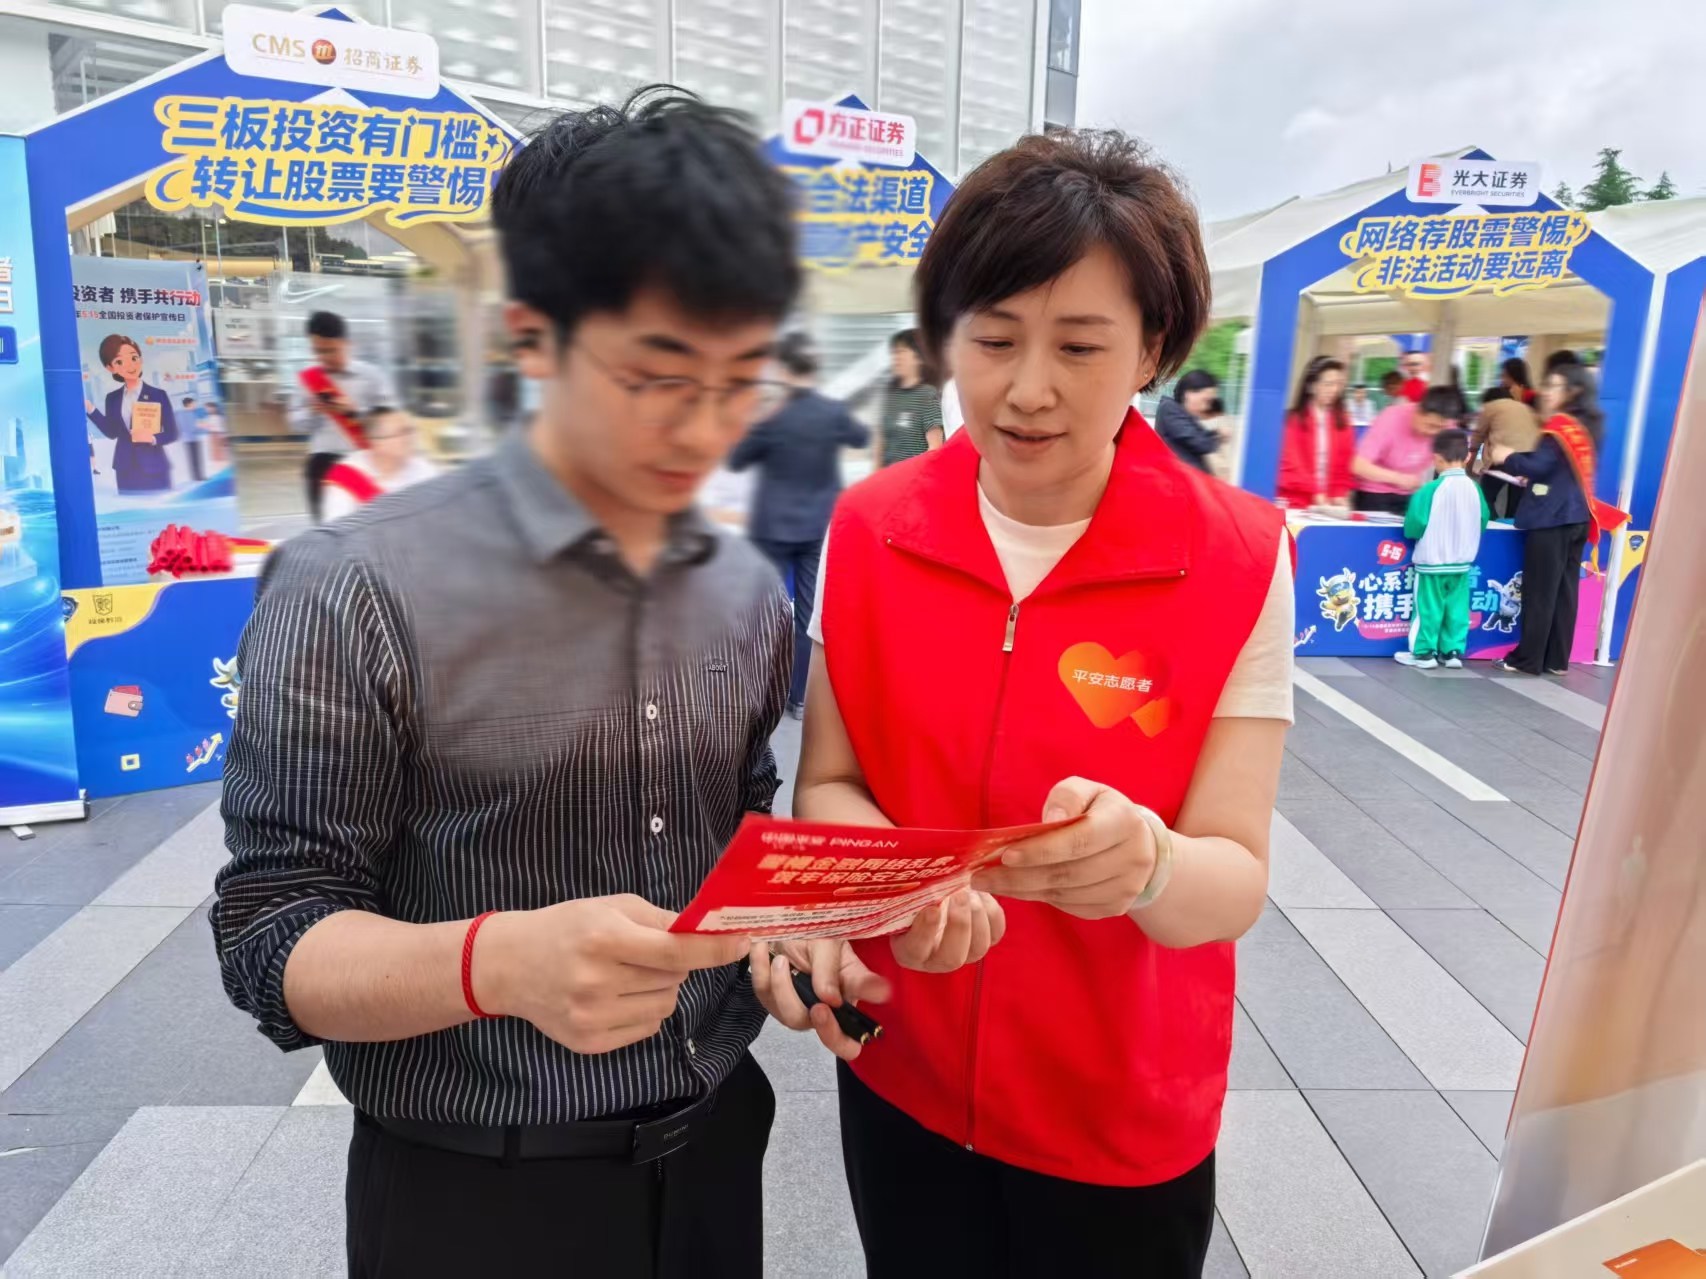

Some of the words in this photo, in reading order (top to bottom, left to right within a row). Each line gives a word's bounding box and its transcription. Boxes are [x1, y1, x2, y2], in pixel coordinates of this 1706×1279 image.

[252, 33, 306, 58] CMS
[343, 48, 423, 75] 招商证券
[828, 112, 904, 144] 方正证券
[191, 155, 487, 208] 转让股票要警惕
[1452, 169, 1528, 189] 光大证券
[1490, 190, 1525, 198] SECURITIES
[1376, 249, 1568, 286] 非法活动要远离
[120, 287, 201, 307] 携手共行动
[1072, 669, 1153, 693] 平安志愿者
[829, 837, 899, 849] PINGAN
